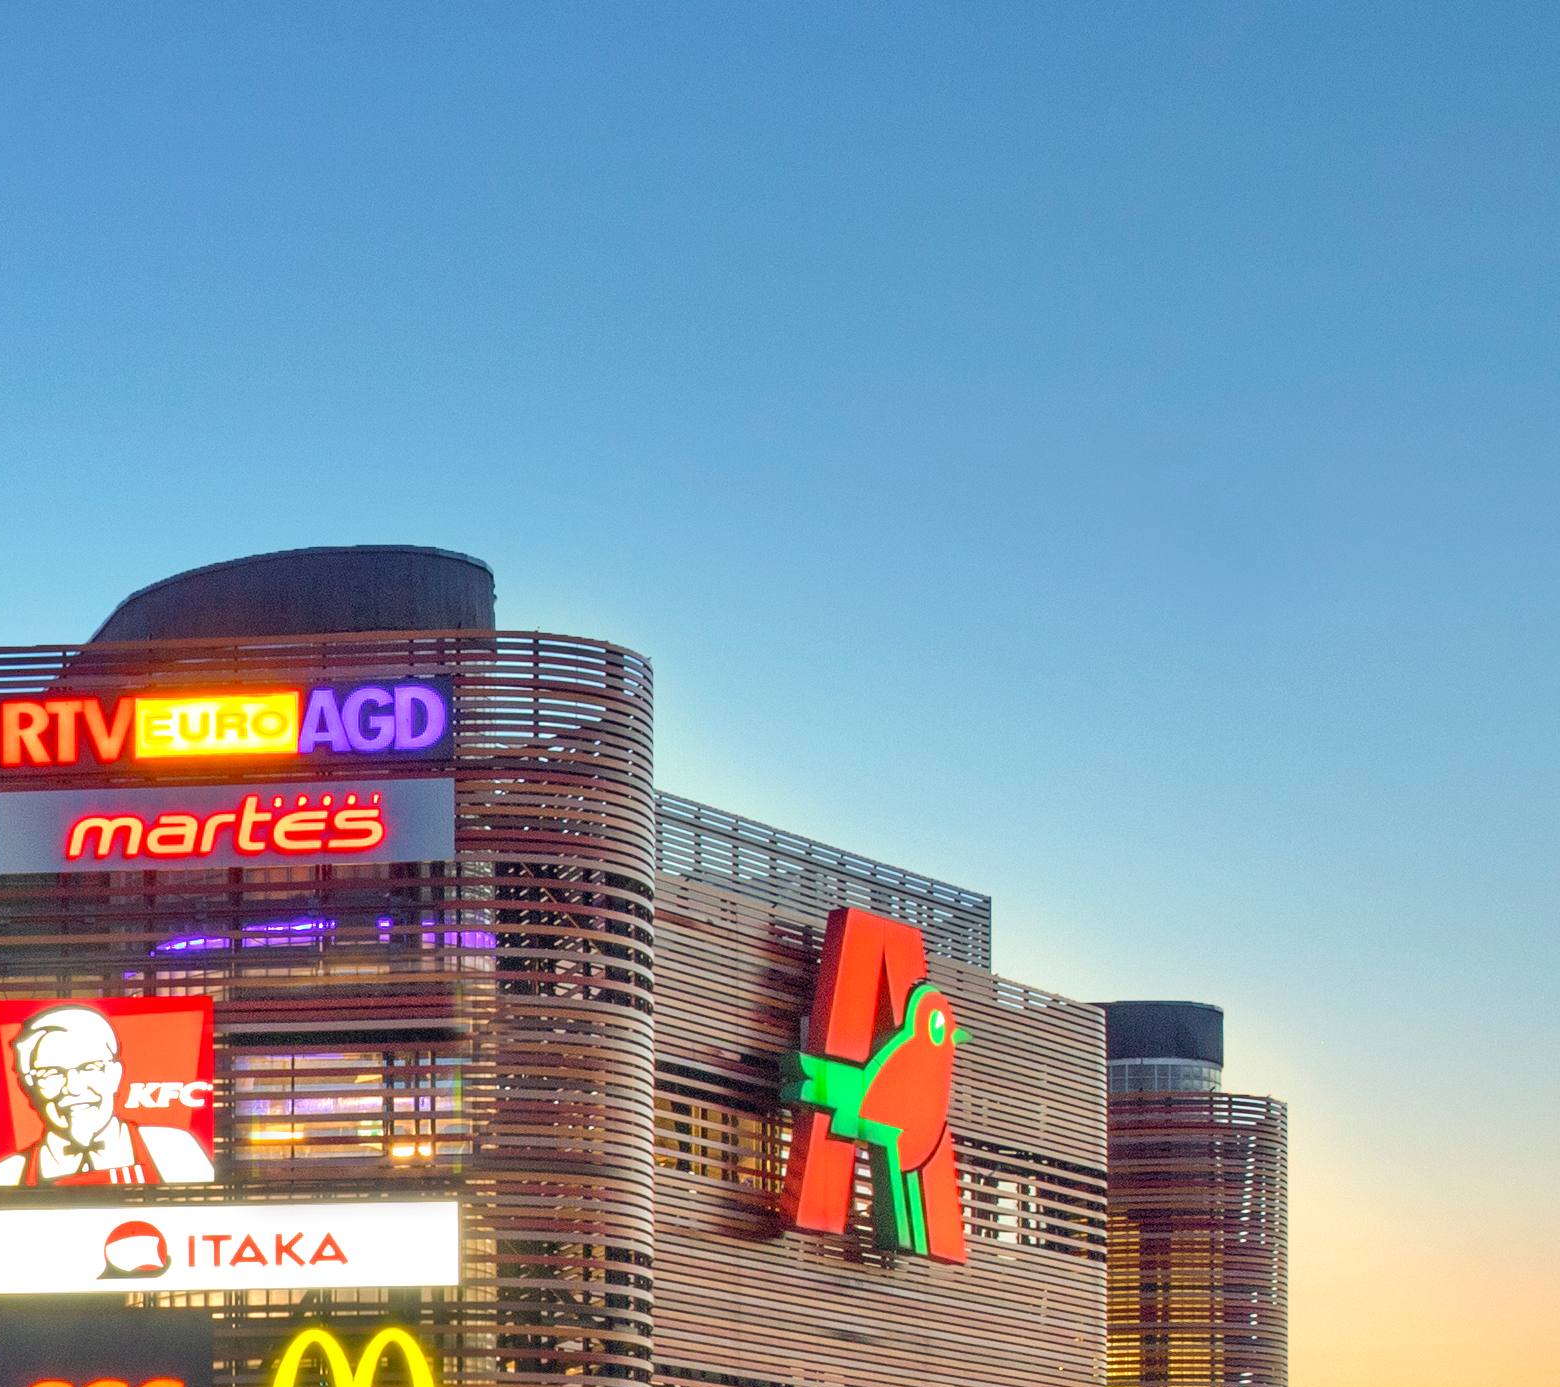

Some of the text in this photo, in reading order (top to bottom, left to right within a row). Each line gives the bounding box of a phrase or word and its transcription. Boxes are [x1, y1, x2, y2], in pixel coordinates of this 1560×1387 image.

[0, 684, 446, 767] RTV EURO AGD
[125, 1083, 208, 1110] KFC
[187, 1232, 349, 1268] ITAKA
